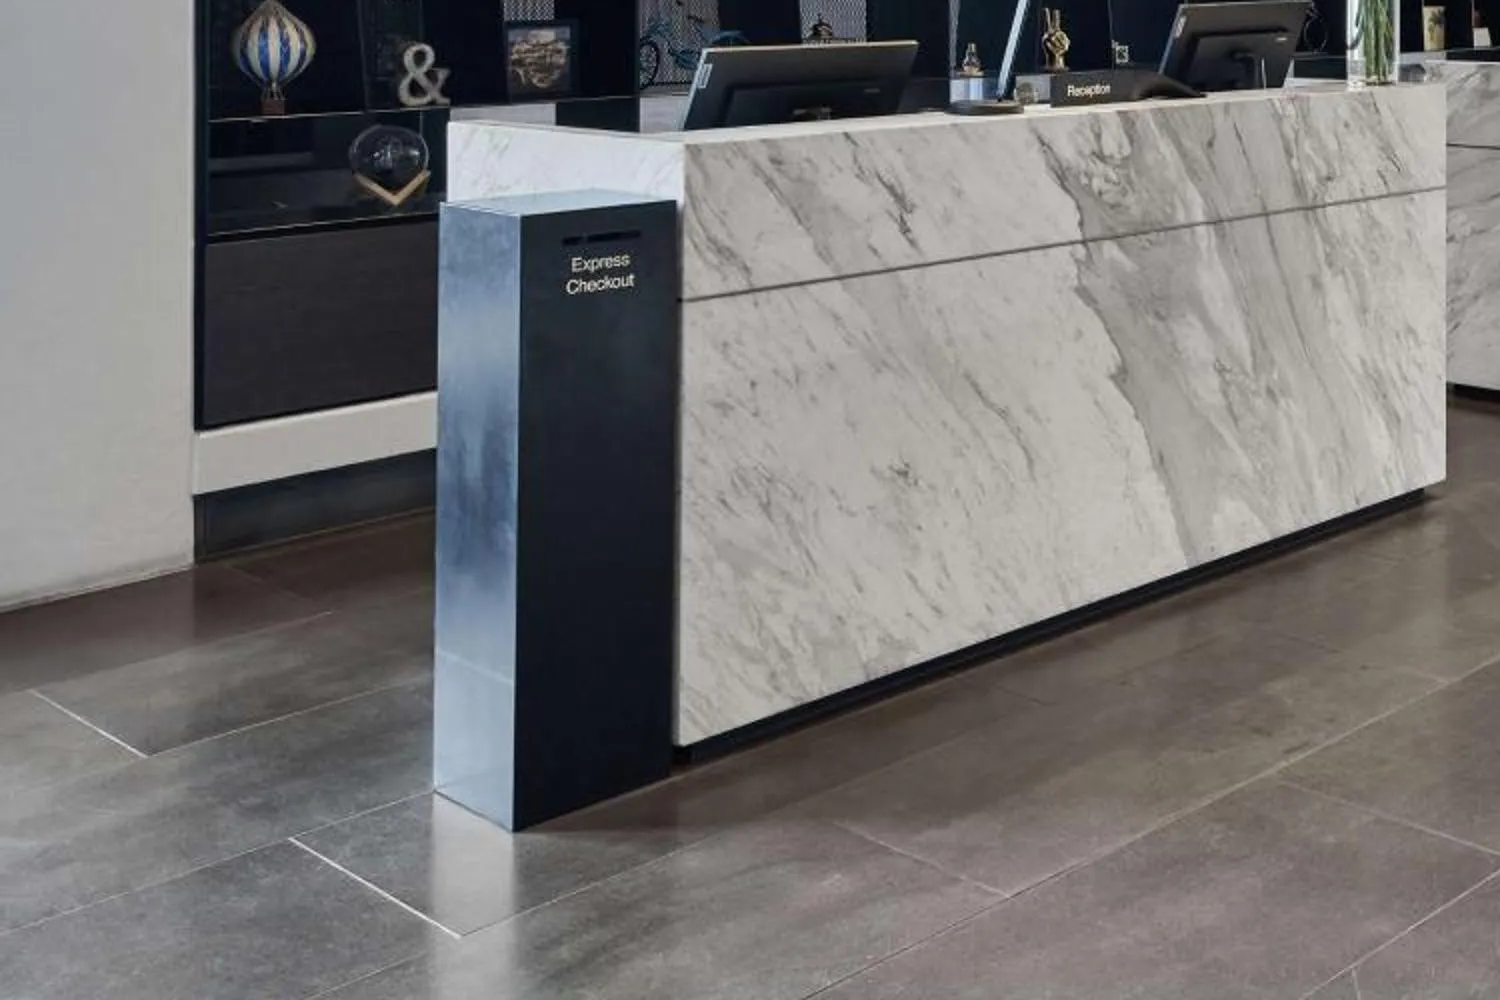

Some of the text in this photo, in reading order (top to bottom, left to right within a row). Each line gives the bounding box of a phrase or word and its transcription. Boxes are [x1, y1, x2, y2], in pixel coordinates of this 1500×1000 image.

[398, 43, 451, 107] &
[1067, 84, 1111, 98] Reception
[571, 254, 631, 273] Express
[566, 273, 635, 295] Checkout
